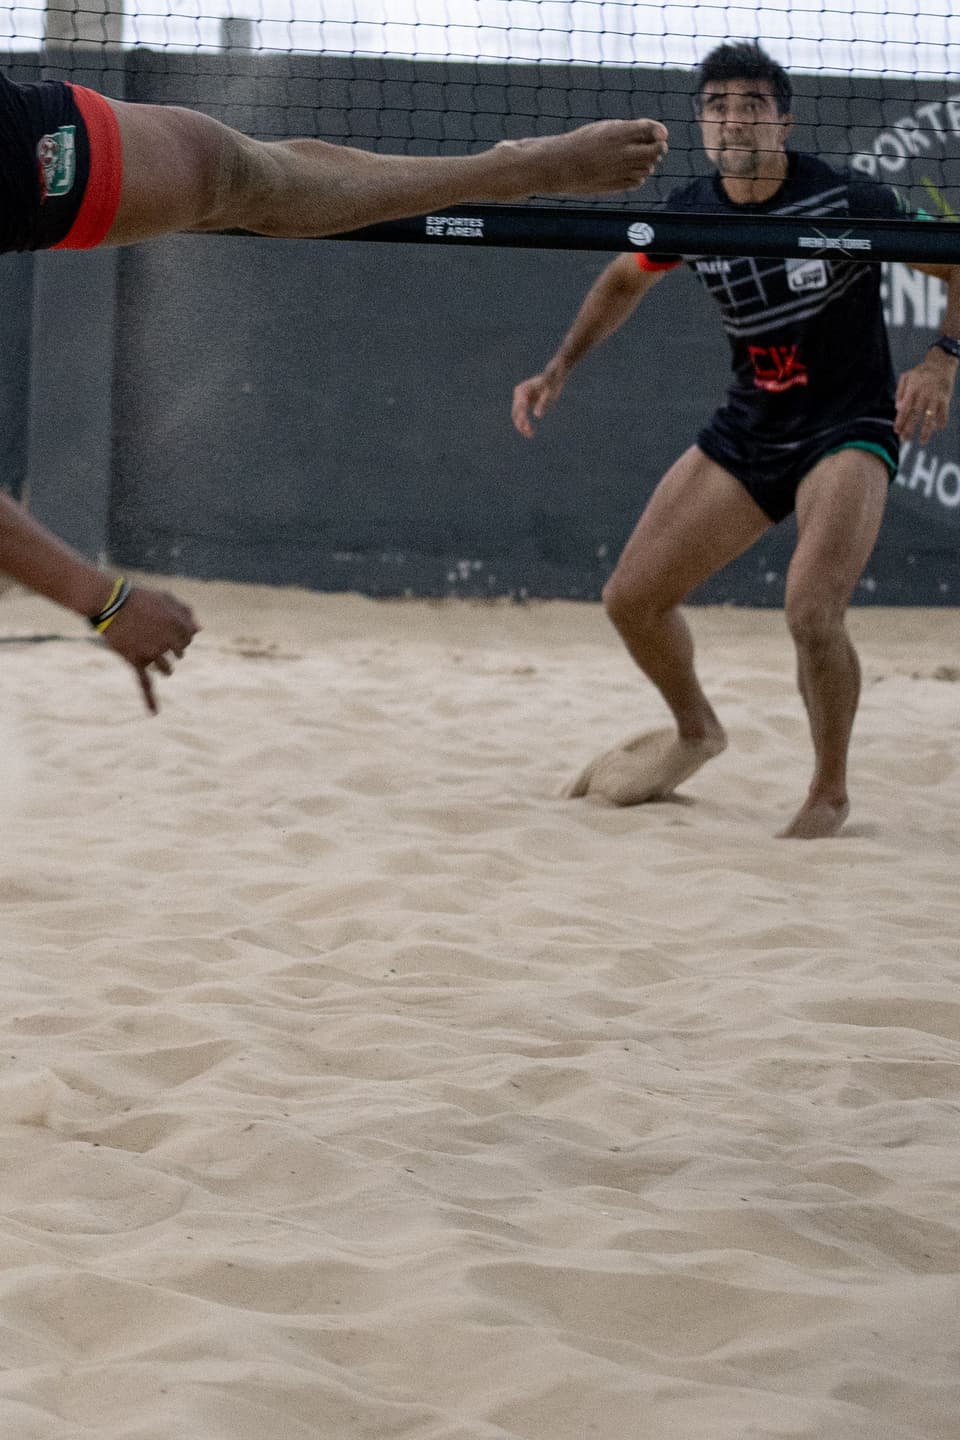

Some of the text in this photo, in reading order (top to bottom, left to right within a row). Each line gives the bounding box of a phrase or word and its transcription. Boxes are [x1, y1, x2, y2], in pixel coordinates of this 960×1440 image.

[425, 216, 484, 228] ESPORTES
[425, 225, 483, 238] DE AREIA
